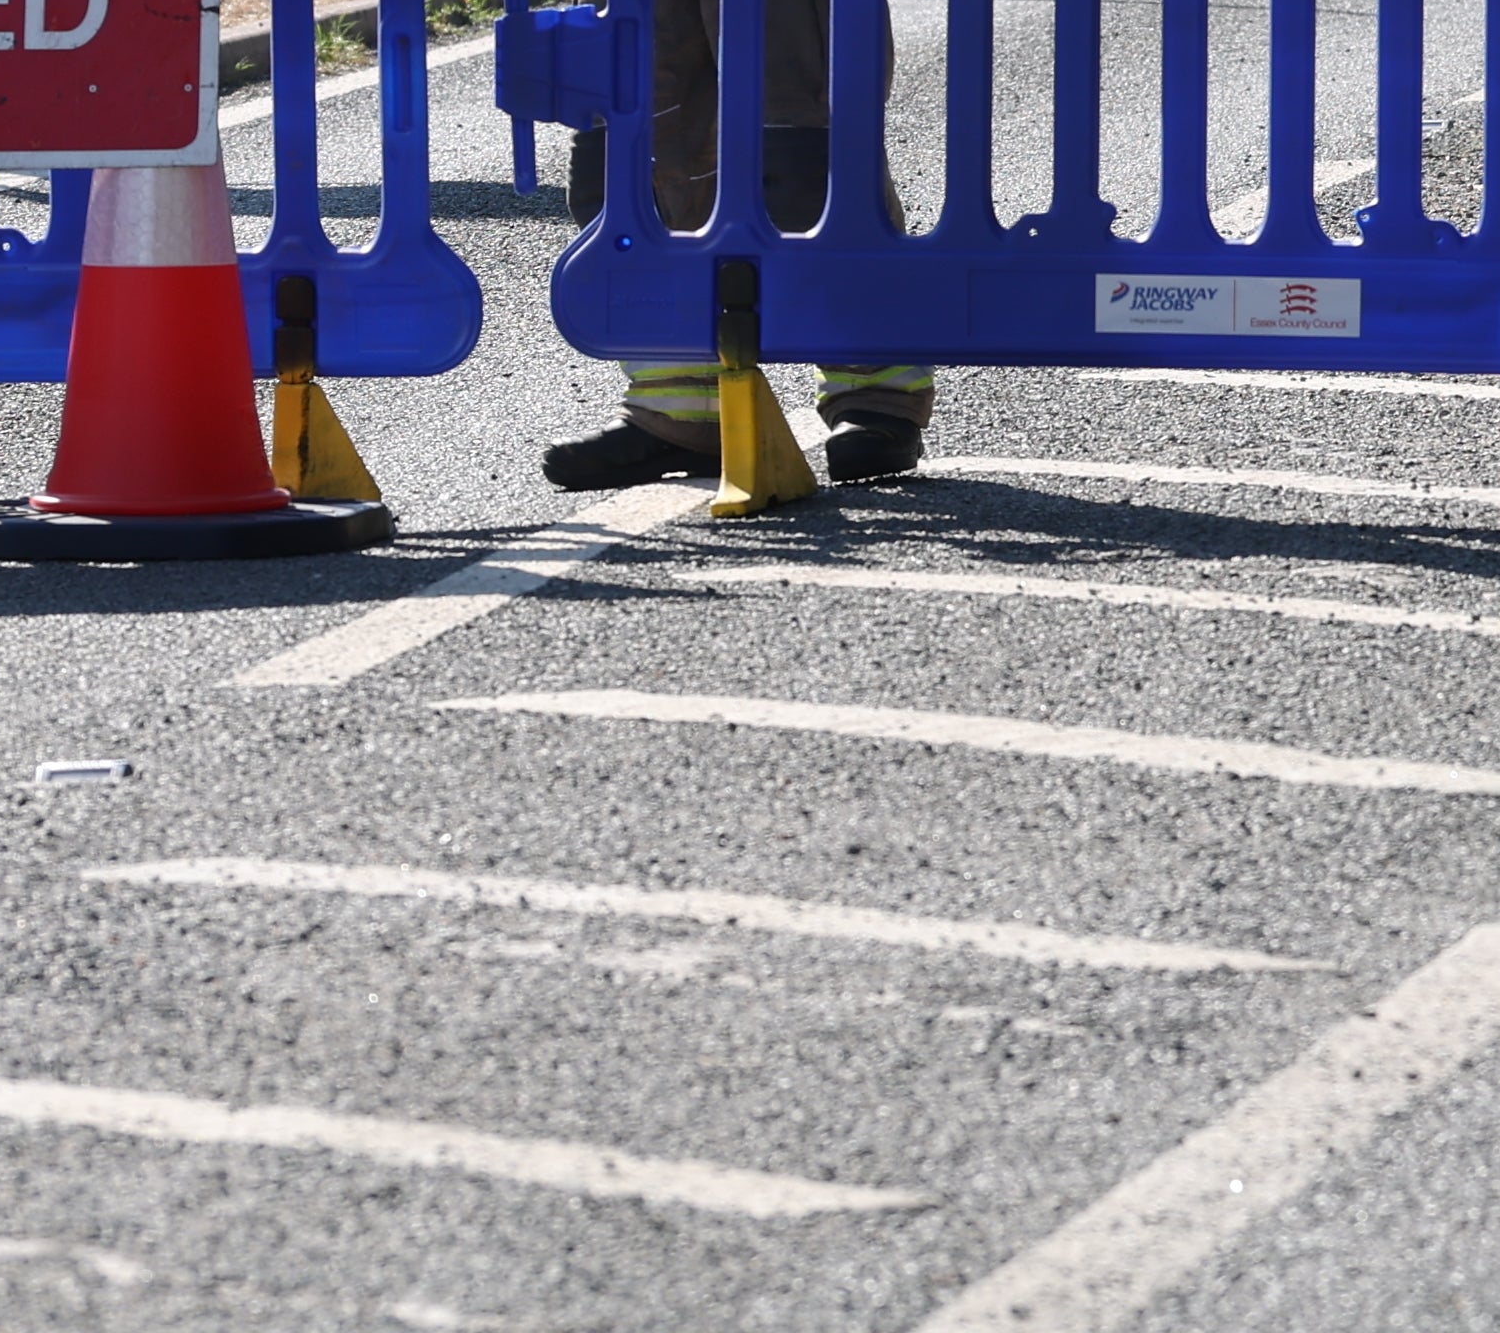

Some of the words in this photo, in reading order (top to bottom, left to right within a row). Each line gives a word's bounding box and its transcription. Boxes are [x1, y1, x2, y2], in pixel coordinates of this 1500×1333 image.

[1133, 286, 1218, 300] RINGWAY
[1129, 298, 1195, 311] JACOBS
[1250, 317, 1277, 328] Essex
[1278, 317, 1311, 330] County
[1312, 318, 1347, 329] Council
